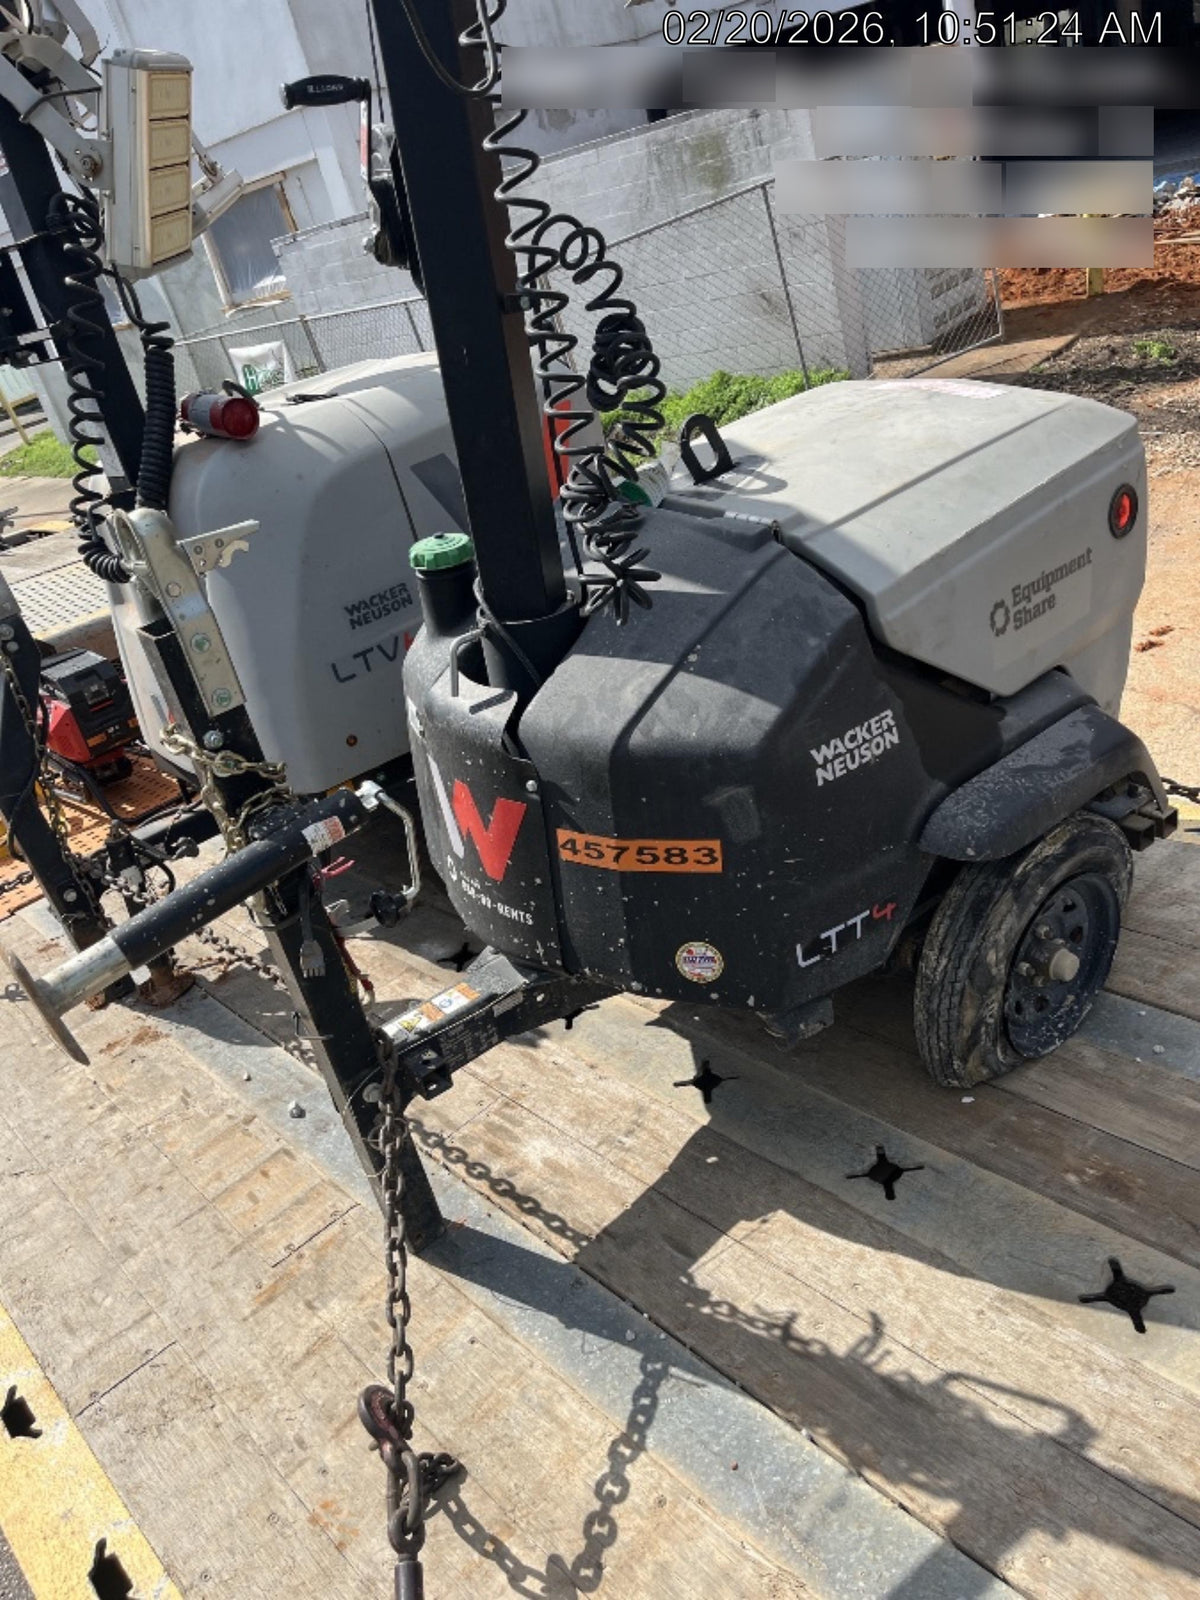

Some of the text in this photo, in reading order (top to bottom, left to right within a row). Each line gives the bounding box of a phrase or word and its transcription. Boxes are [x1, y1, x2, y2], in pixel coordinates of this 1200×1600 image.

[1011, 546, 1093, 607] Equipment
[343, 582, 410, 617] WACKER
[348, 593, 414, 630] NEUSON
[1012, 593, 1056, 631] Share
[809, 709, 897, 766] WACKER
[815, 726, 900, 787] NEUSON
[558, 837, 720, 866] 457583
